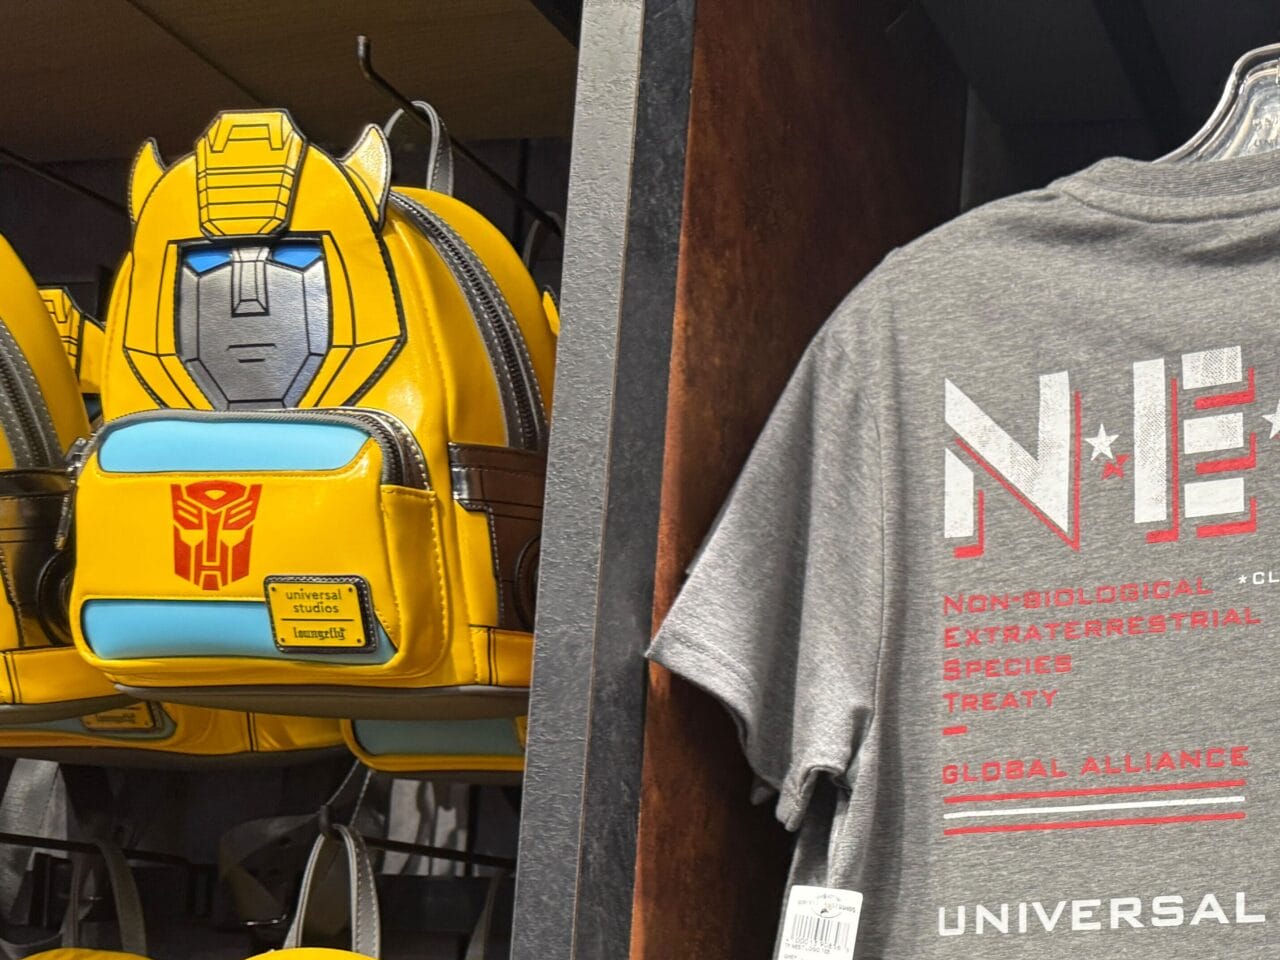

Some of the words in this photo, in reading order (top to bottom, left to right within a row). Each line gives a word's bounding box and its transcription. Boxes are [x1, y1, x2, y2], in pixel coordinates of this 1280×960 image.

[285, 587, 342, 600] universal
[293, 601, 339, 613] studios
[943, 576, 1213, 616] NON-BIOLOGICAL
[943, 607, 1262, 649] EXTRATERRESTRIAL
[942, 653, 1073, 681] SPECIES
[942, 688, 1058, 714] TREATY
[942, 758, 1068, 785] GLOBAL
[1081, 745, 1250, 776] ALLIANCE
[937, 890, 1267, 937] UNIVERSAL
